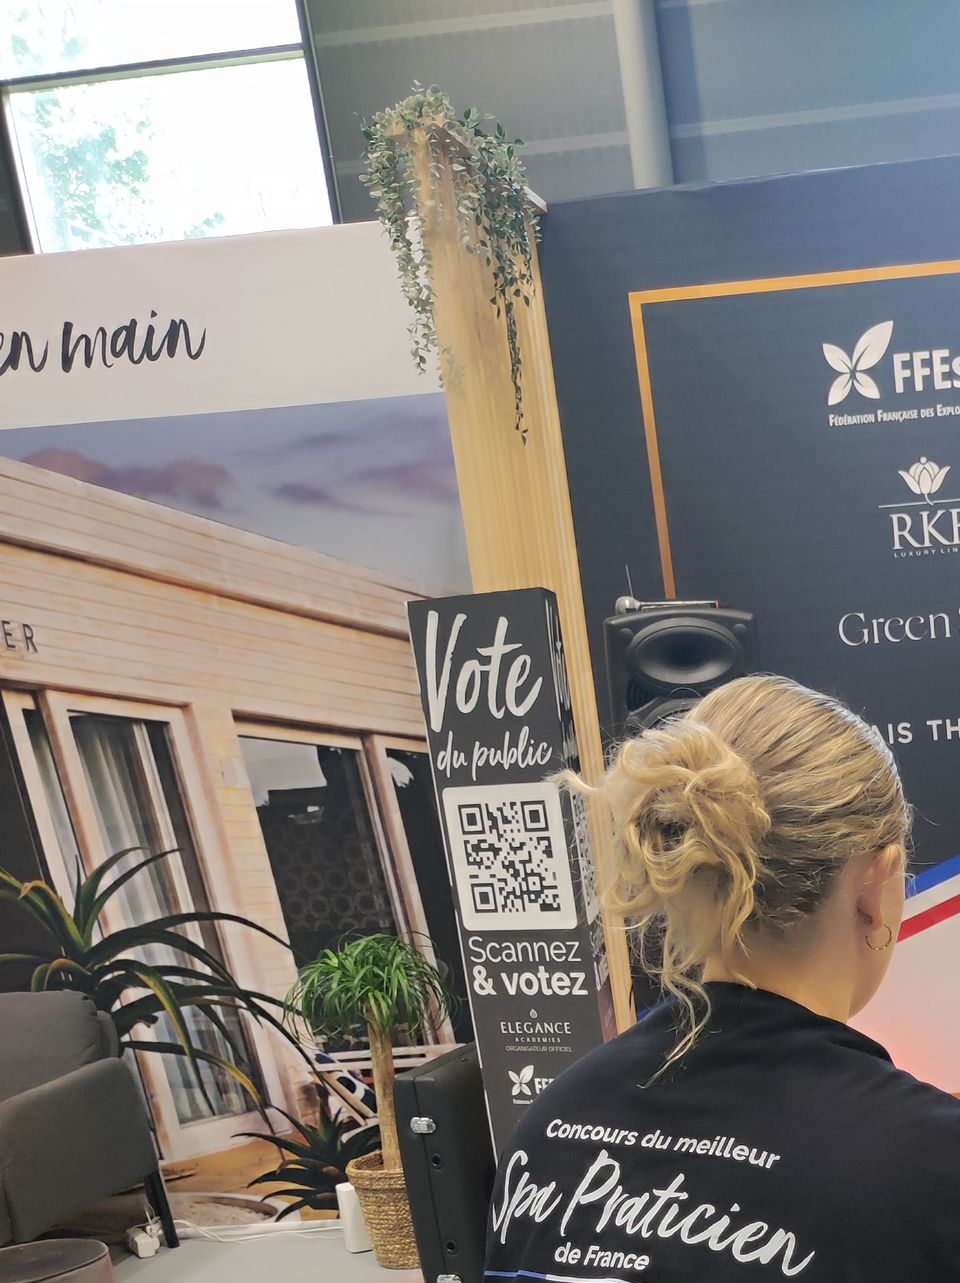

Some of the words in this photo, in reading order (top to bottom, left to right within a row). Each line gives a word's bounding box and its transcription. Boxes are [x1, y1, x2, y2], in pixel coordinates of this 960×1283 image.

[61, 309, 206, 373] main
[894, 549, 936, 558] LUXURY
[1, 620, 38, 653] ER
[838, 612, 951, 646] Green
[425, 610, 543, 733] Vote
[436, 731, 469, 778] du
[471, 724, 553, 781] public
[468, 935, 582, 963] Scannez
[472, 966, 497, 996] &
[500, 970, 589, 997] votez
[500, 1021, 572, 1034] ELEGANCE
[546, 1118, 638, 1147] Concours
[641, 1130, 671, 1150] du
[674, 1135, 781, 1169] meilleur
[492, 1150, 563, 1244] Spa
[560, 1149, 815, 1276] Praticien
[554, 1241, 581, 1265] de
[583, 1245, 650, 1271] France
